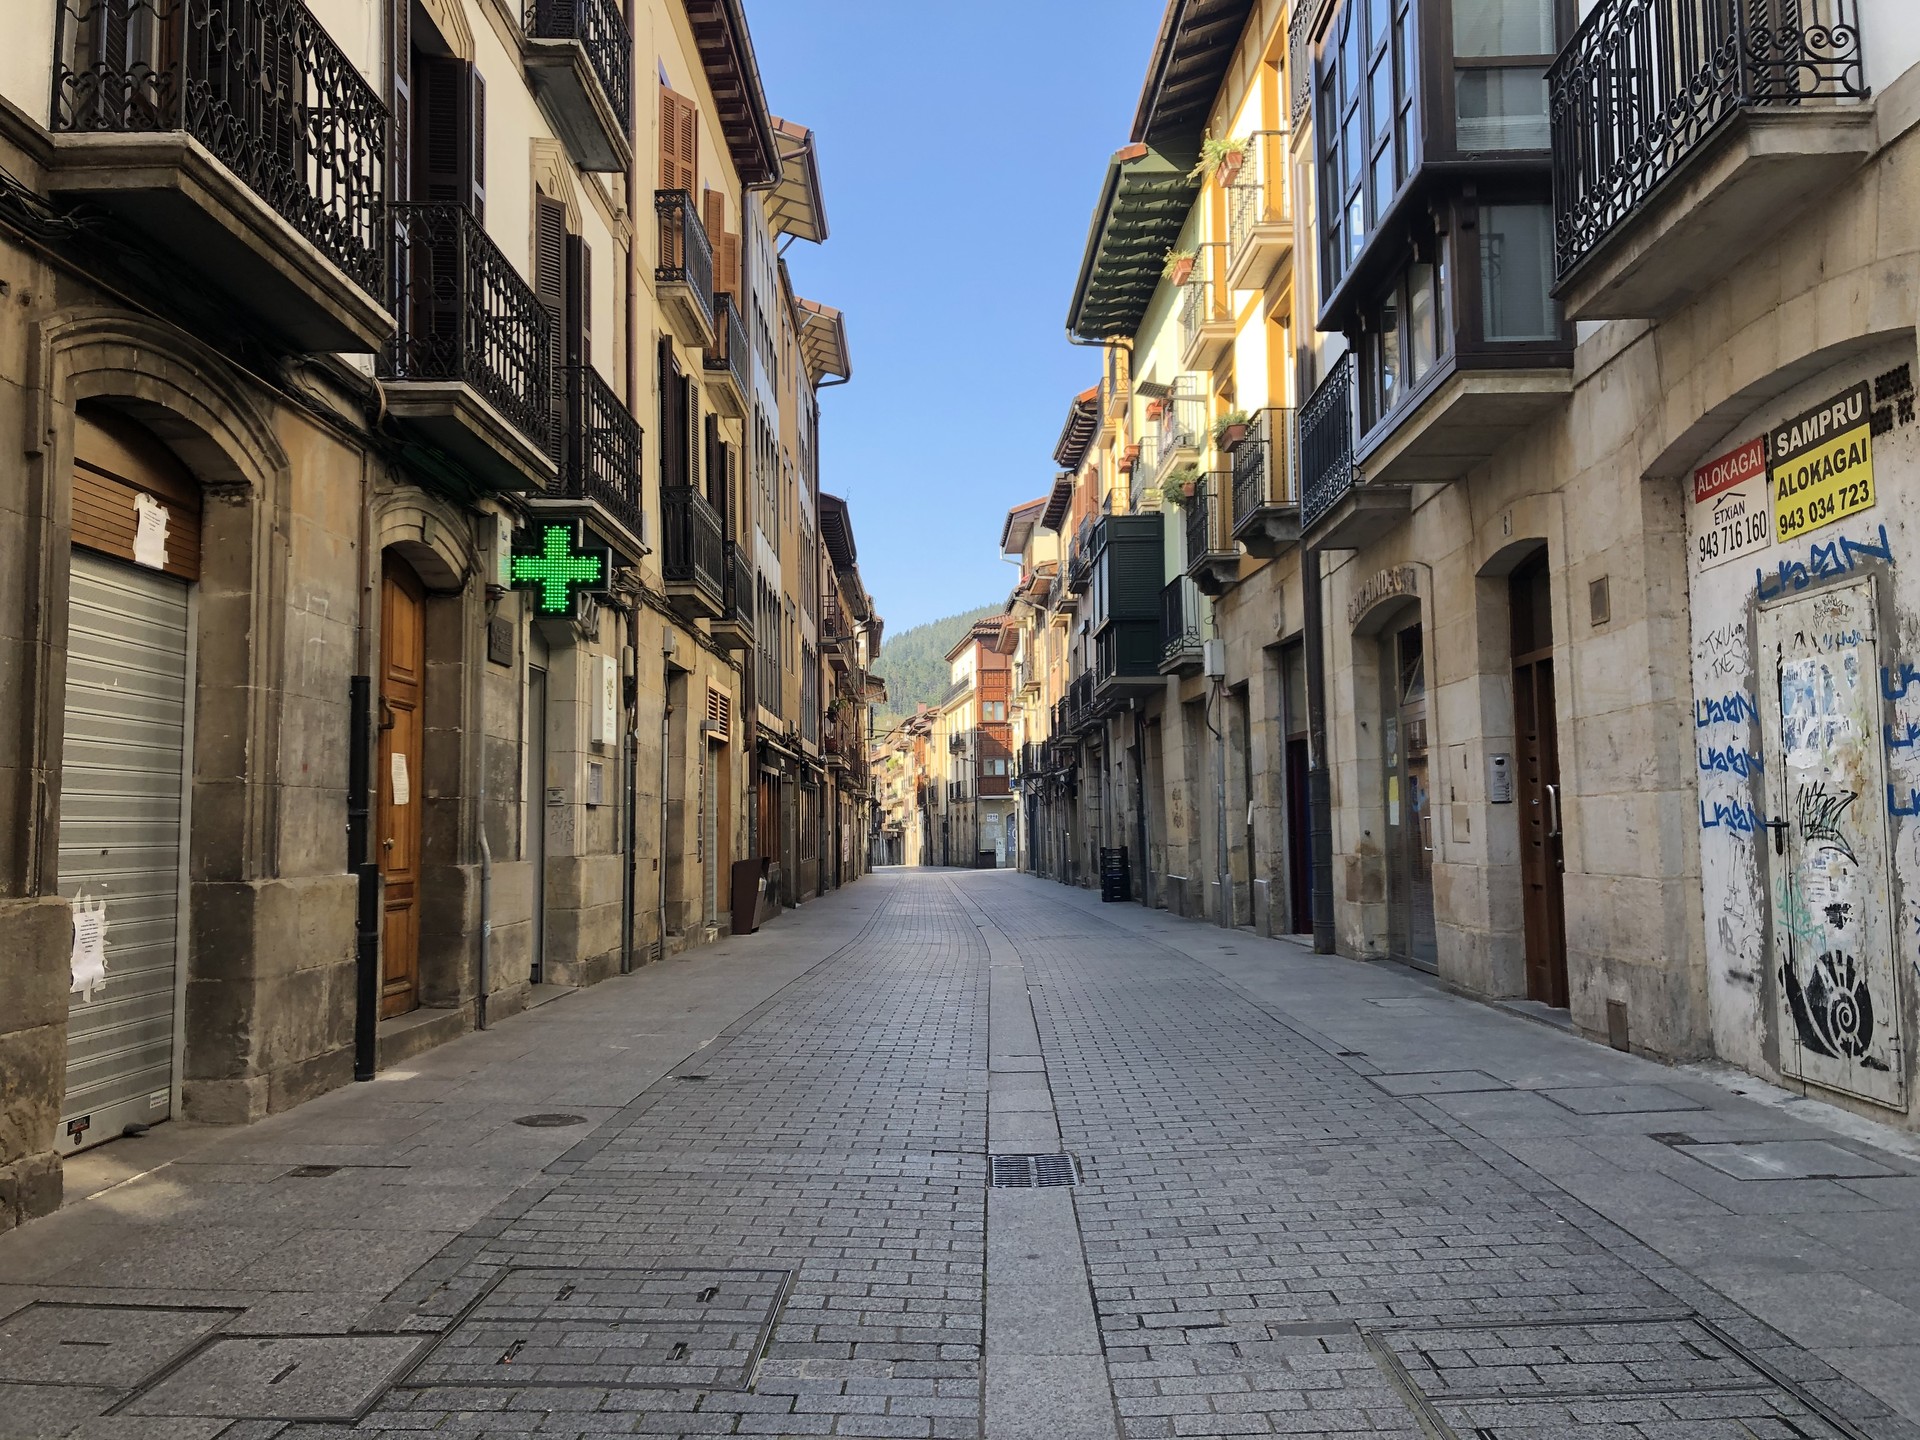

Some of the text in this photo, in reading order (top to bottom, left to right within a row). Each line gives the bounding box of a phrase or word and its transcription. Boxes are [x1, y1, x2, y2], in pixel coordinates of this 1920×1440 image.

[1777, 391, 1863, 457] SAMPRU
[1698, 445, 1761, 495] ALOKAGAI
[1777, 437, 1867, 501] ALOKAGAI
[1779, 479, 1869, 535] 943 034 723
[1699, 510, 1767, 562] 943 716 160
